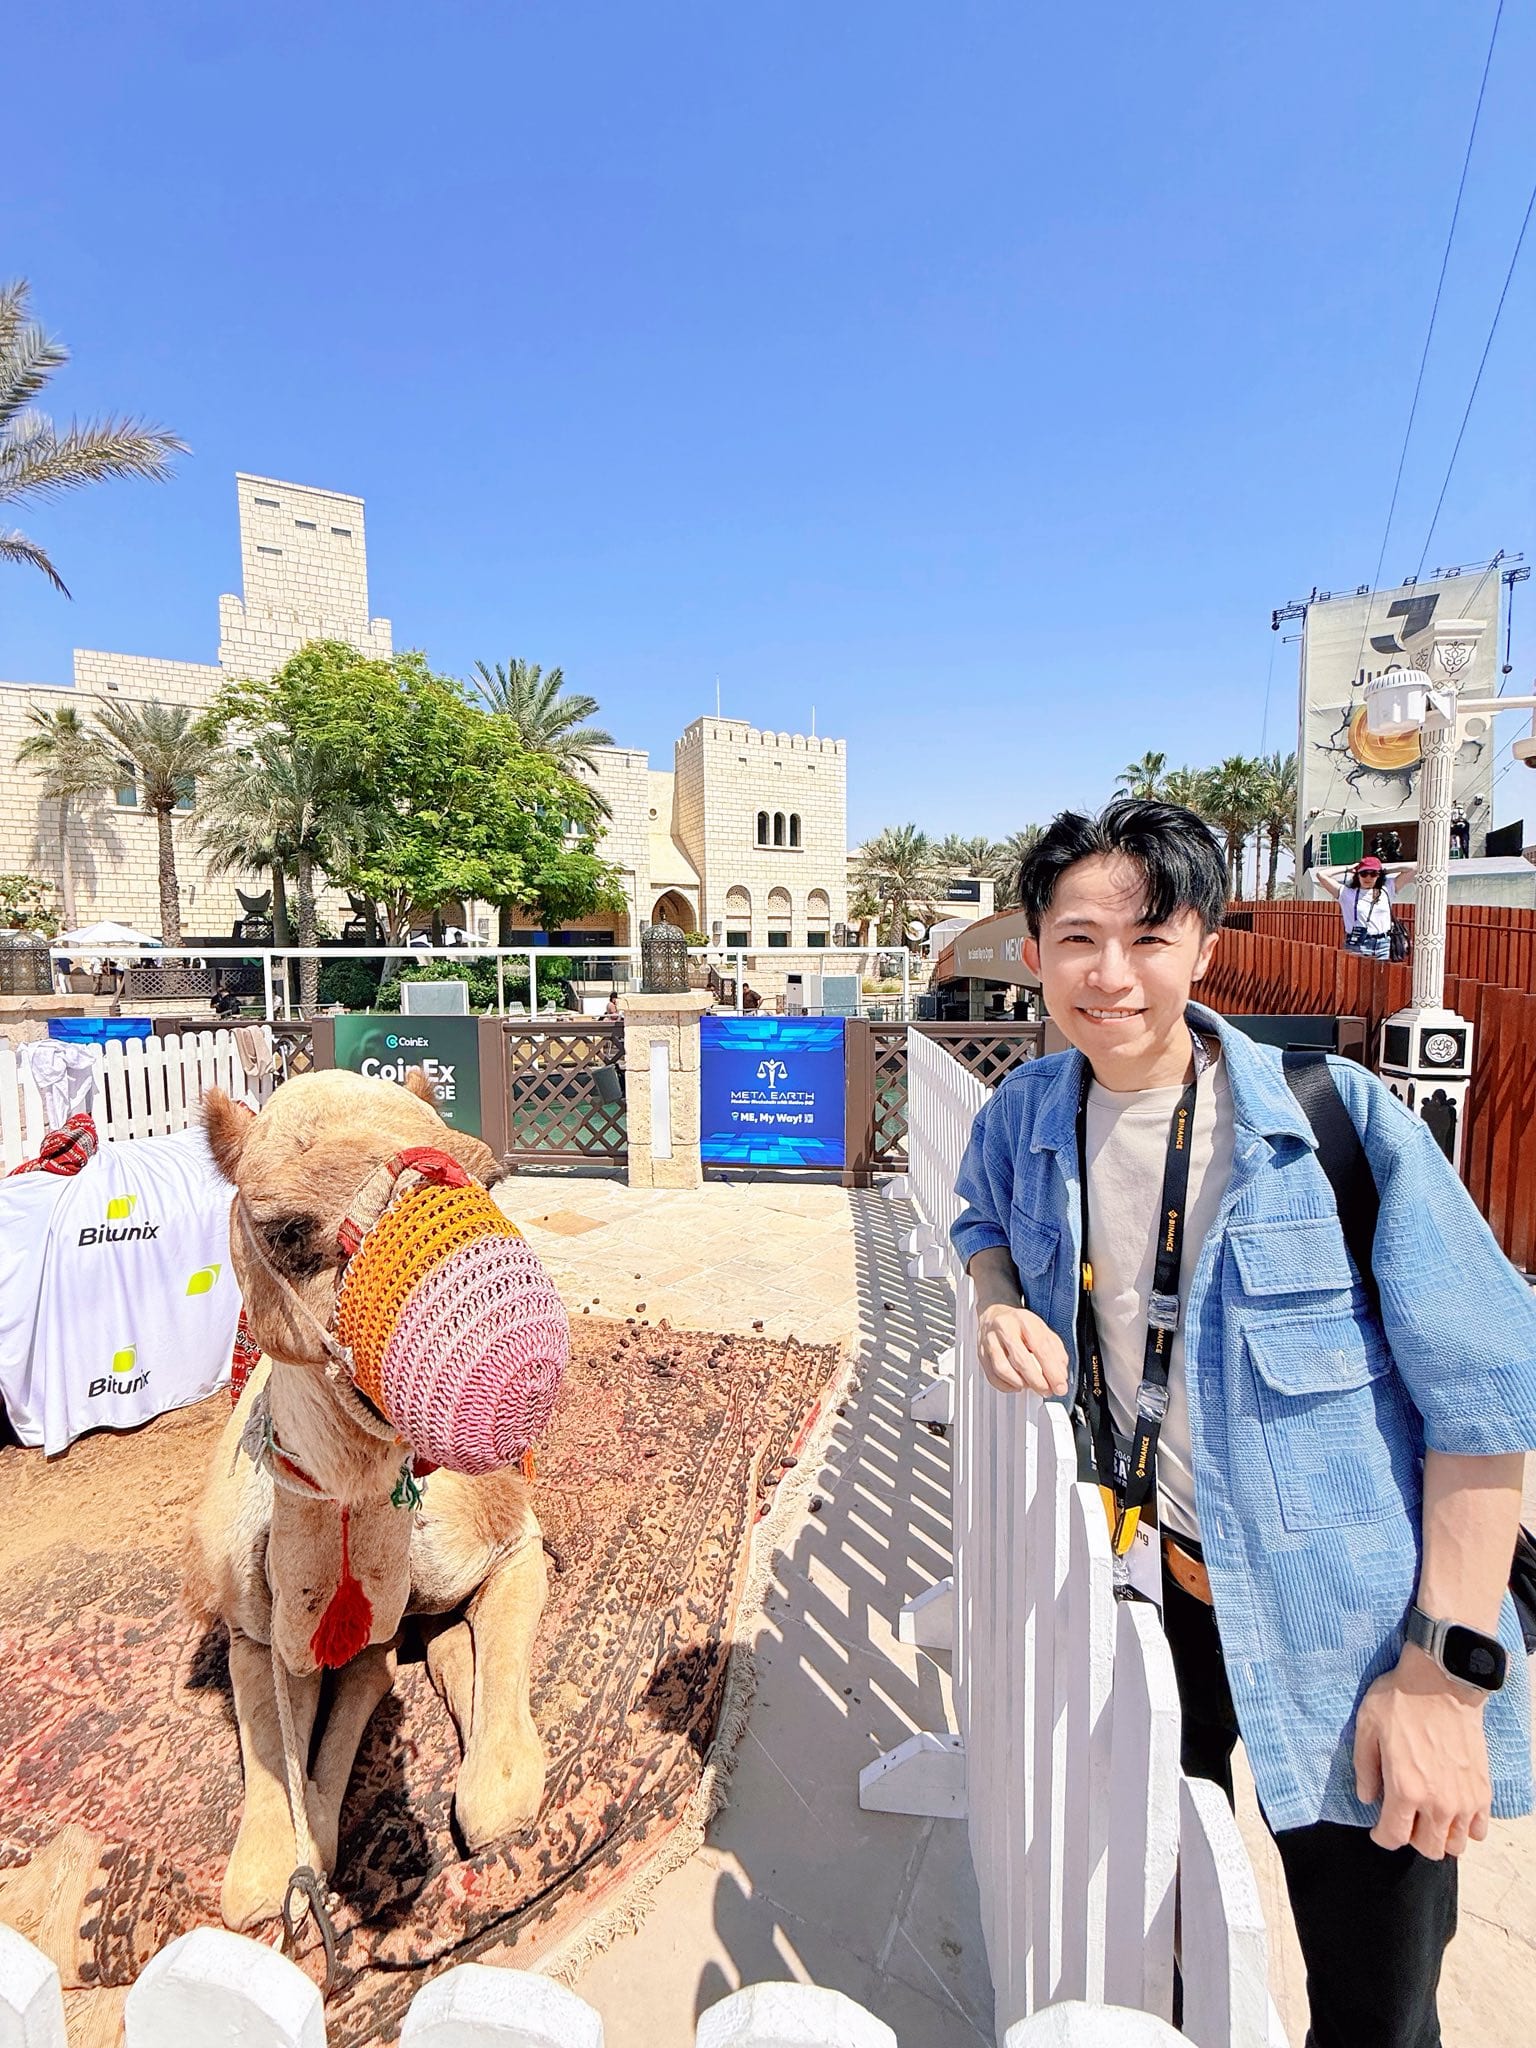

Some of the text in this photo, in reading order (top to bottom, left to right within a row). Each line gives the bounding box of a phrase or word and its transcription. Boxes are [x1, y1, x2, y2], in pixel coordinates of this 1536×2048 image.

[399, 1037, 429, 1047] CoinEx
[730, 1091, 814, 1100] META EARTH
[740, 1112, 803, 1125] ME, My Way!
[1175, 1118, 1186, 1150] BINANCE
[78, 1221, 160, 1247] Bitunix
[1166, 1218, 1178, 1252] BINANCE
[1155, 1327, 1166, 1354] NANCE
[88, 1370, 151, 1398] Bitunix
[1092, 1355, 1100, 1387] BINANCE
[1138, 1435, 1150, 1469] BINANCE
